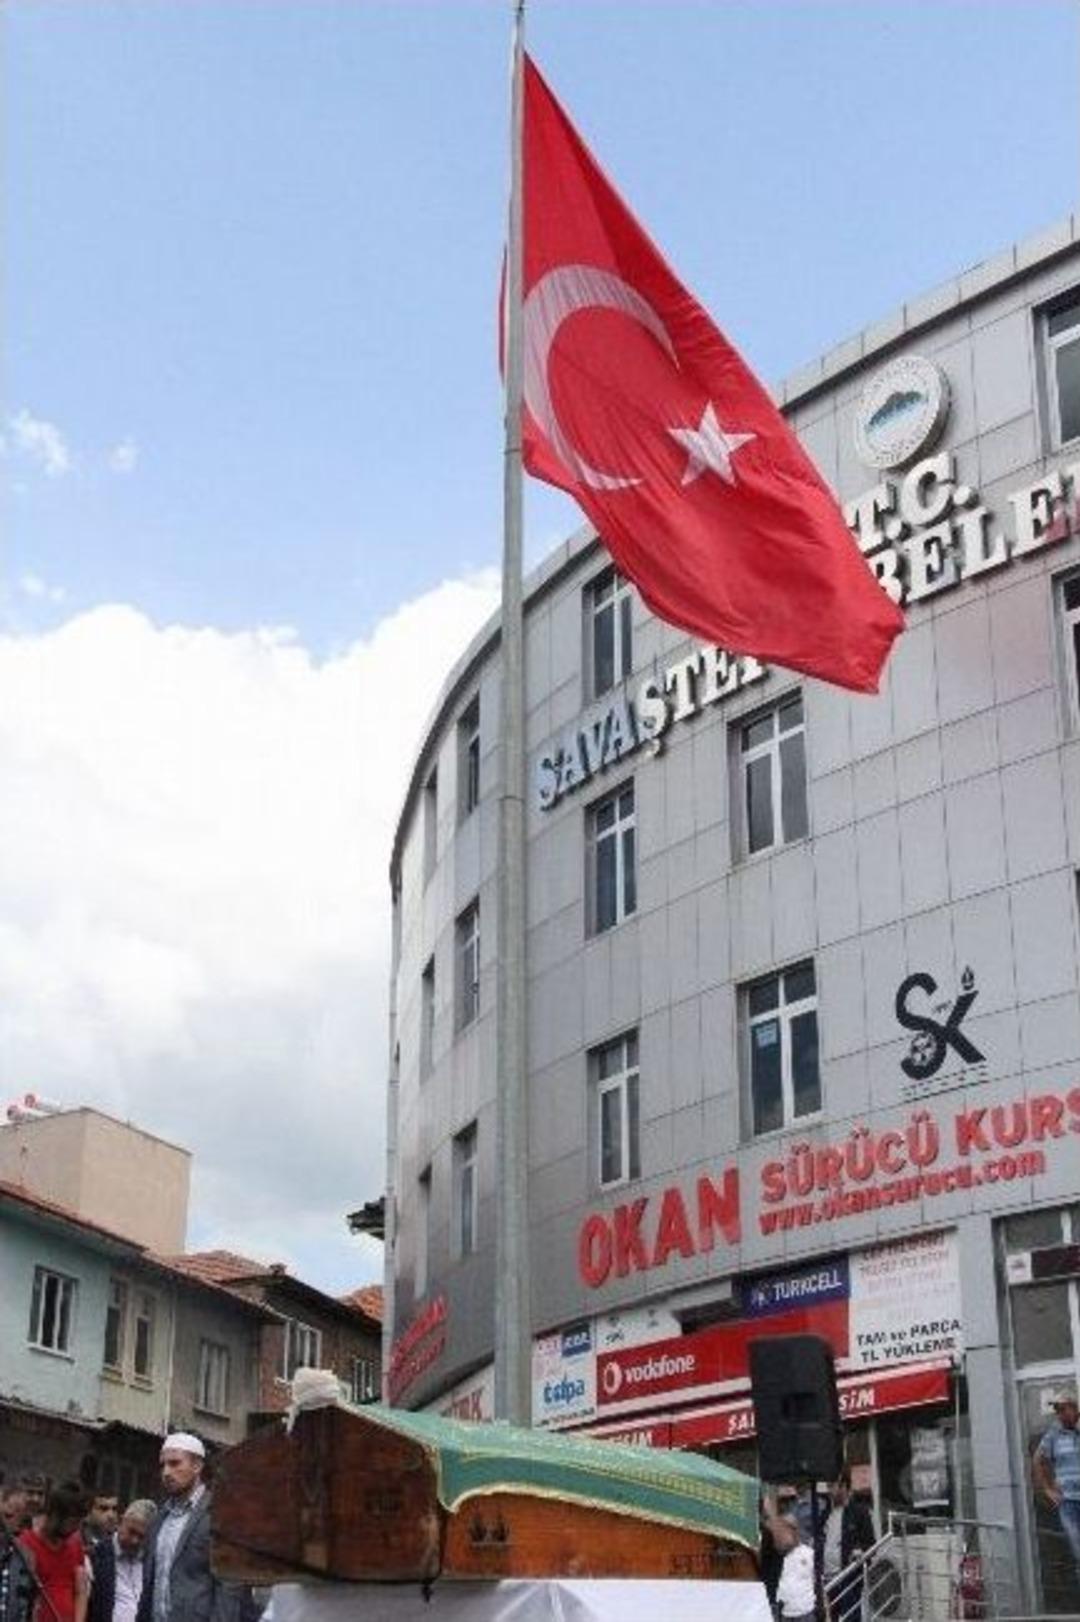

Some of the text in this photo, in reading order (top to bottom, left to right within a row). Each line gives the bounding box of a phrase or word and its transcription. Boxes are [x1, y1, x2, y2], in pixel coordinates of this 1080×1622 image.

[866, 462, 1080, 605] BELE
[760, 1110, 940, 1203] SÜRÜCÜ
[580, 1164, 742, 1289] OKAN
[625, 1354, 696, 1383] vodafone
